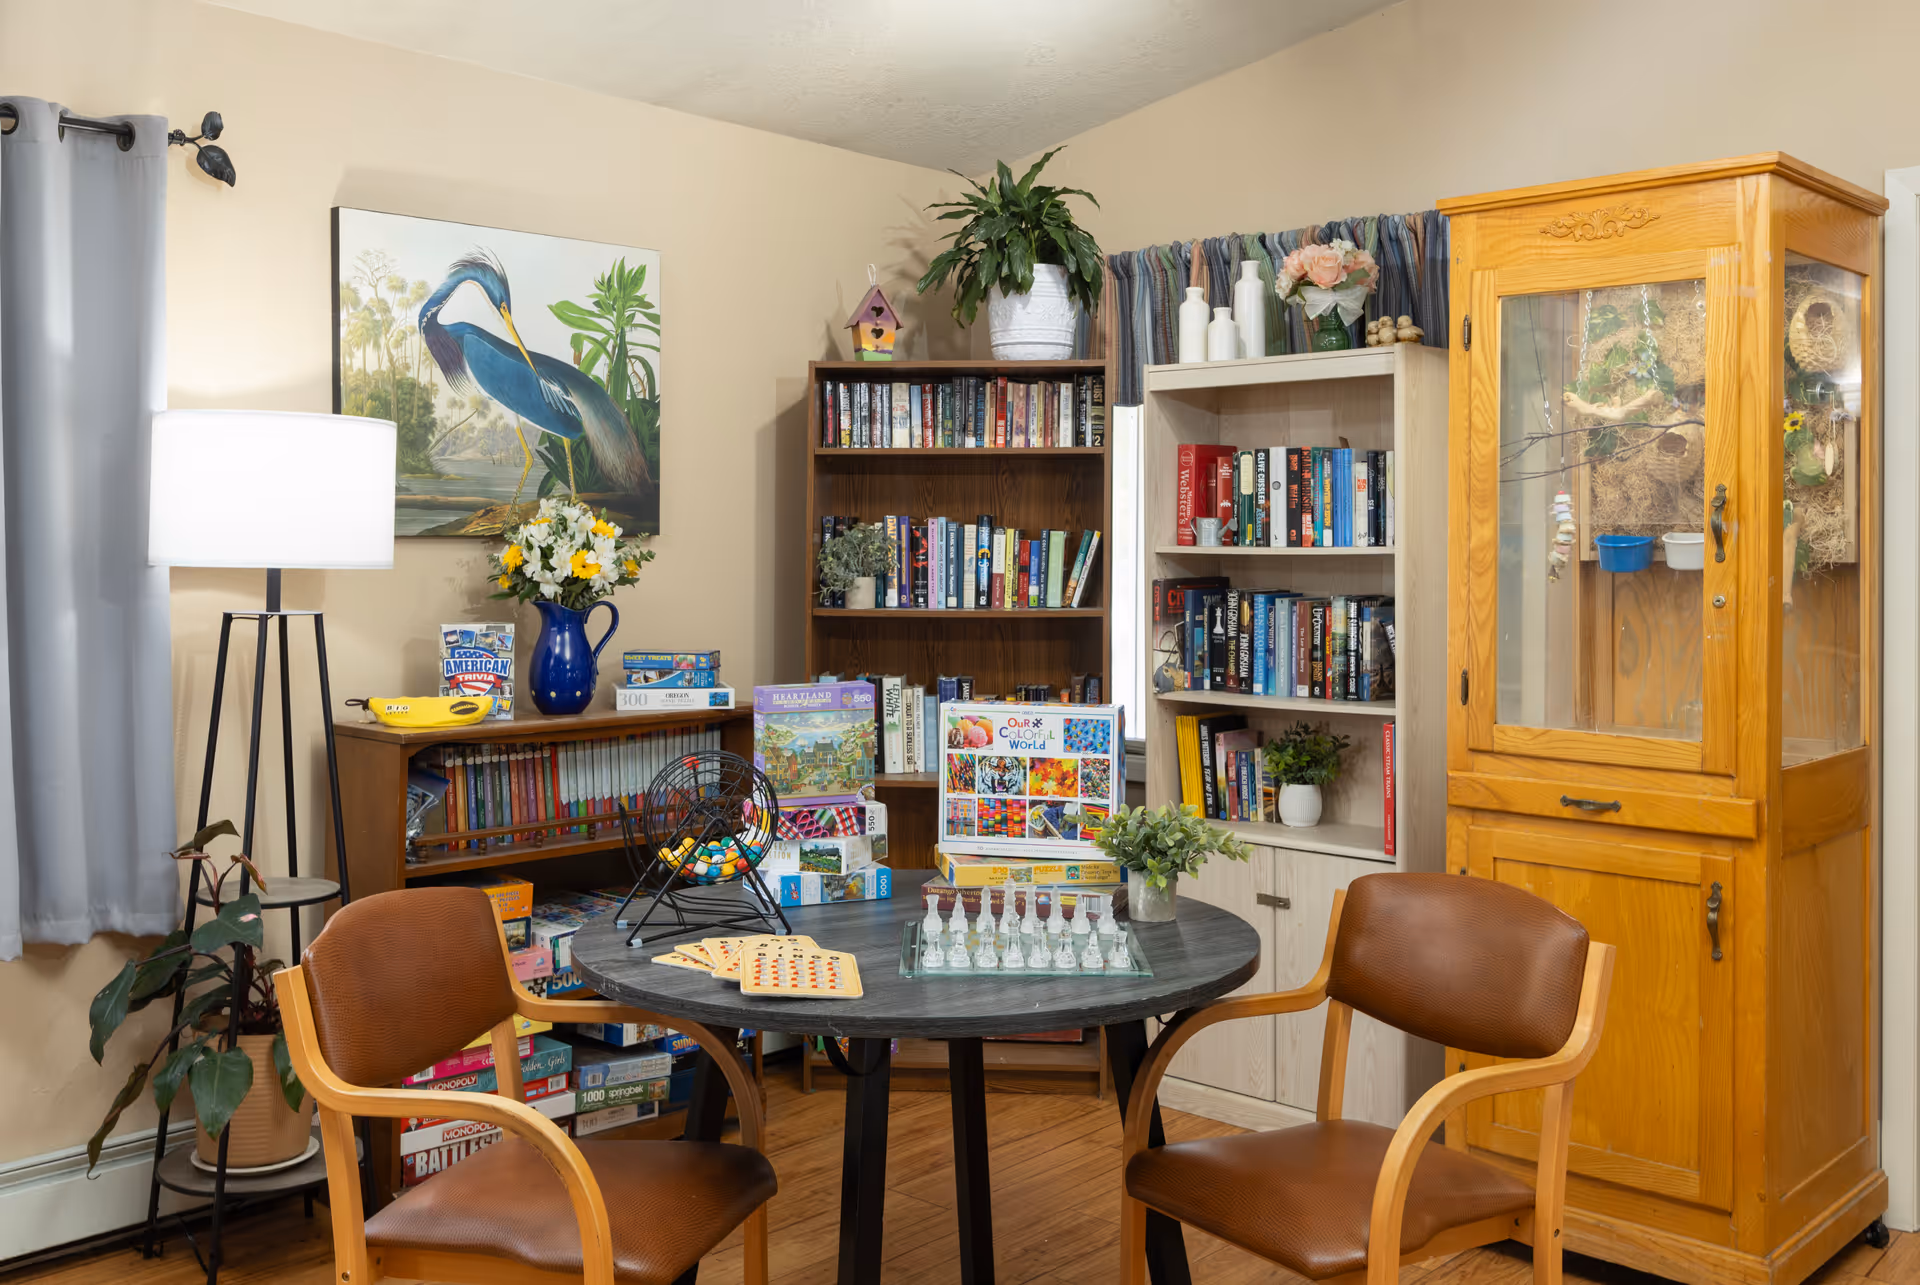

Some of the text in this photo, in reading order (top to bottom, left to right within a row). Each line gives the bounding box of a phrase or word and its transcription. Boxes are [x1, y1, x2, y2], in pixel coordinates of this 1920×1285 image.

[1093, 384, 1103, 403] LOST
[1094, 435, 1101, 446] 2
[1257, 452, 1265, 504] CLIVE CUSSLER
[1301, 449, 1312, 514] CRAIG JOHNSON
[1179, 469, 1190, 525] Webster's
[1228, 592, 1237, 608] JOHN
[1228, 609, 1237, 637] GRISHAM
[1240, 633, 1249, 678] JOHN GRISHAM
[445, 659, 510, 676] AMERICAN
[456, 673, 495, 682] TRIVIA
[772, 691, 832, 701] HEARTLAND
[853, 694, 872, 703] 550
[886, 688, 894, 718] WHITE
[892, 684, 900, 714] LETHAL
[1200, 724, 1209, 740] JAMES
[1201, 741, 1210, 767] PATTERSON
[1205, 783, 1213, 792] NO
[927, 887, 955, 895] Durango
[548, 1051, 566, 1072] Girls
[582, 1089, 605, 1103] 1000
[443, 1122, 495, 1141] MONOPOL
